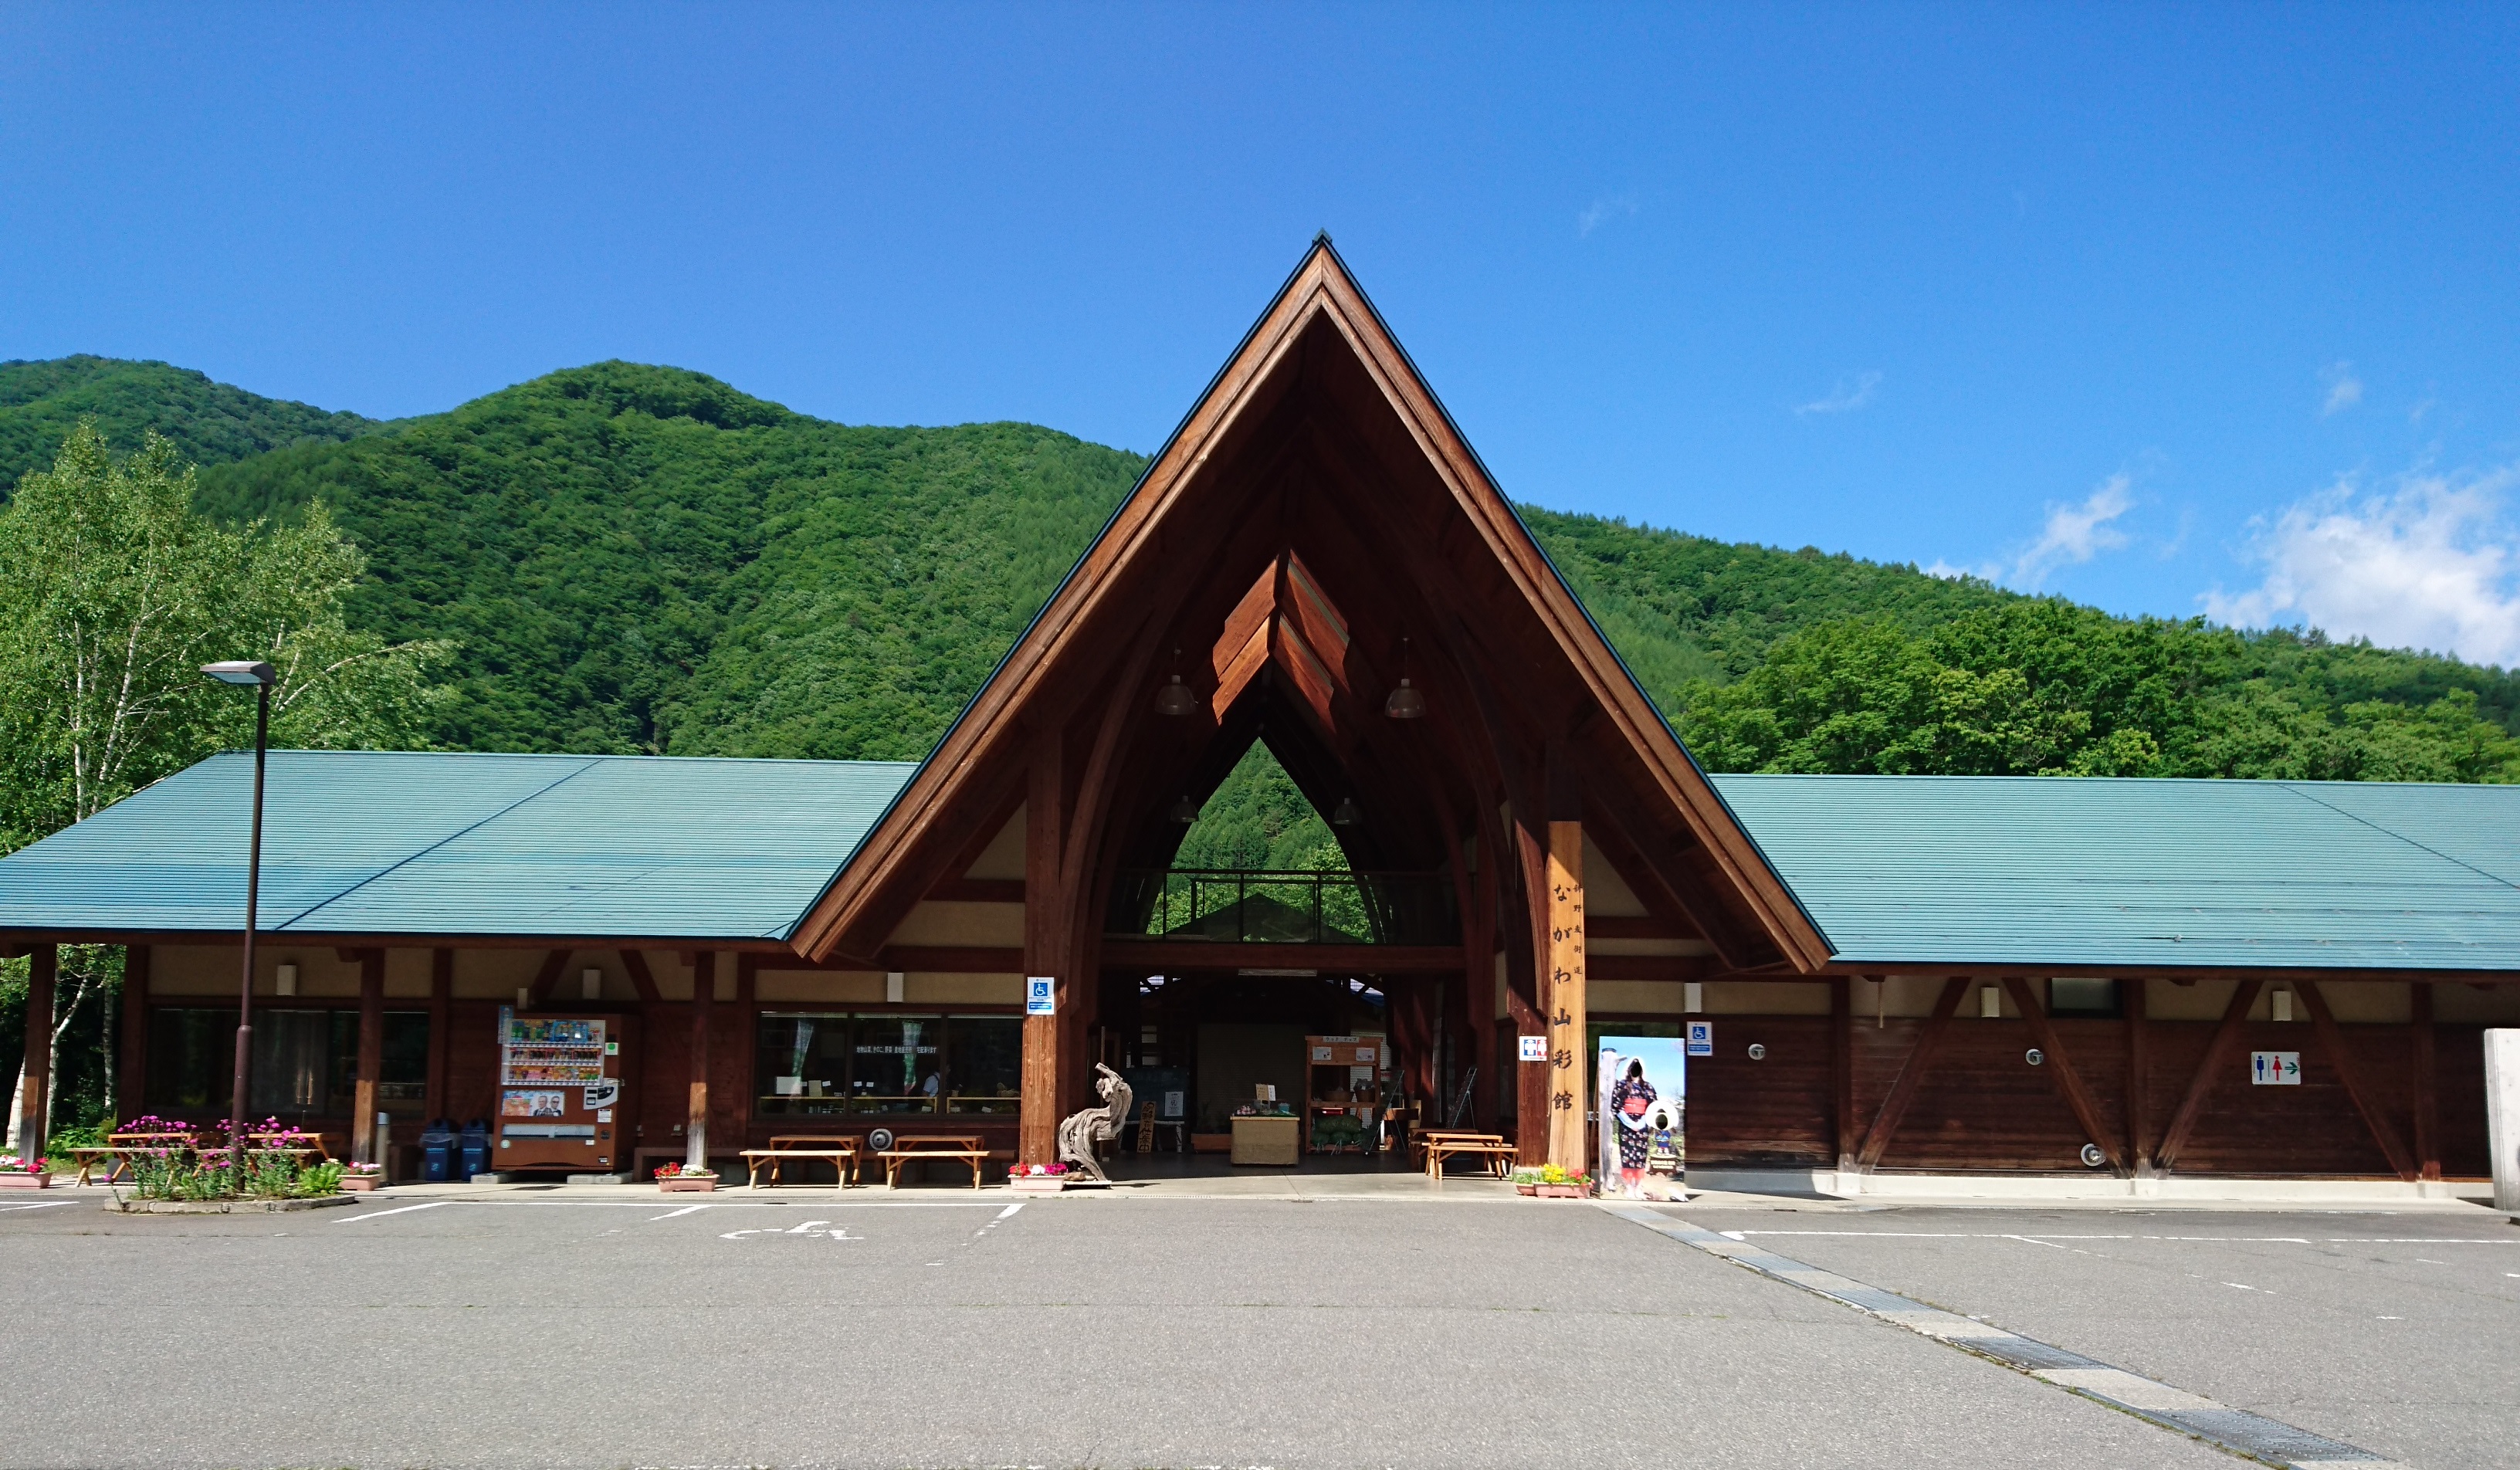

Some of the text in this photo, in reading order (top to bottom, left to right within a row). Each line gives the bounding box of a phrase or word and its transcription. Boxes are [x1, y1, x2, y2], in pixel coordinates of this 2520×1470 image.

[1552, 883, 1573, 1112] ながわ山彩館
